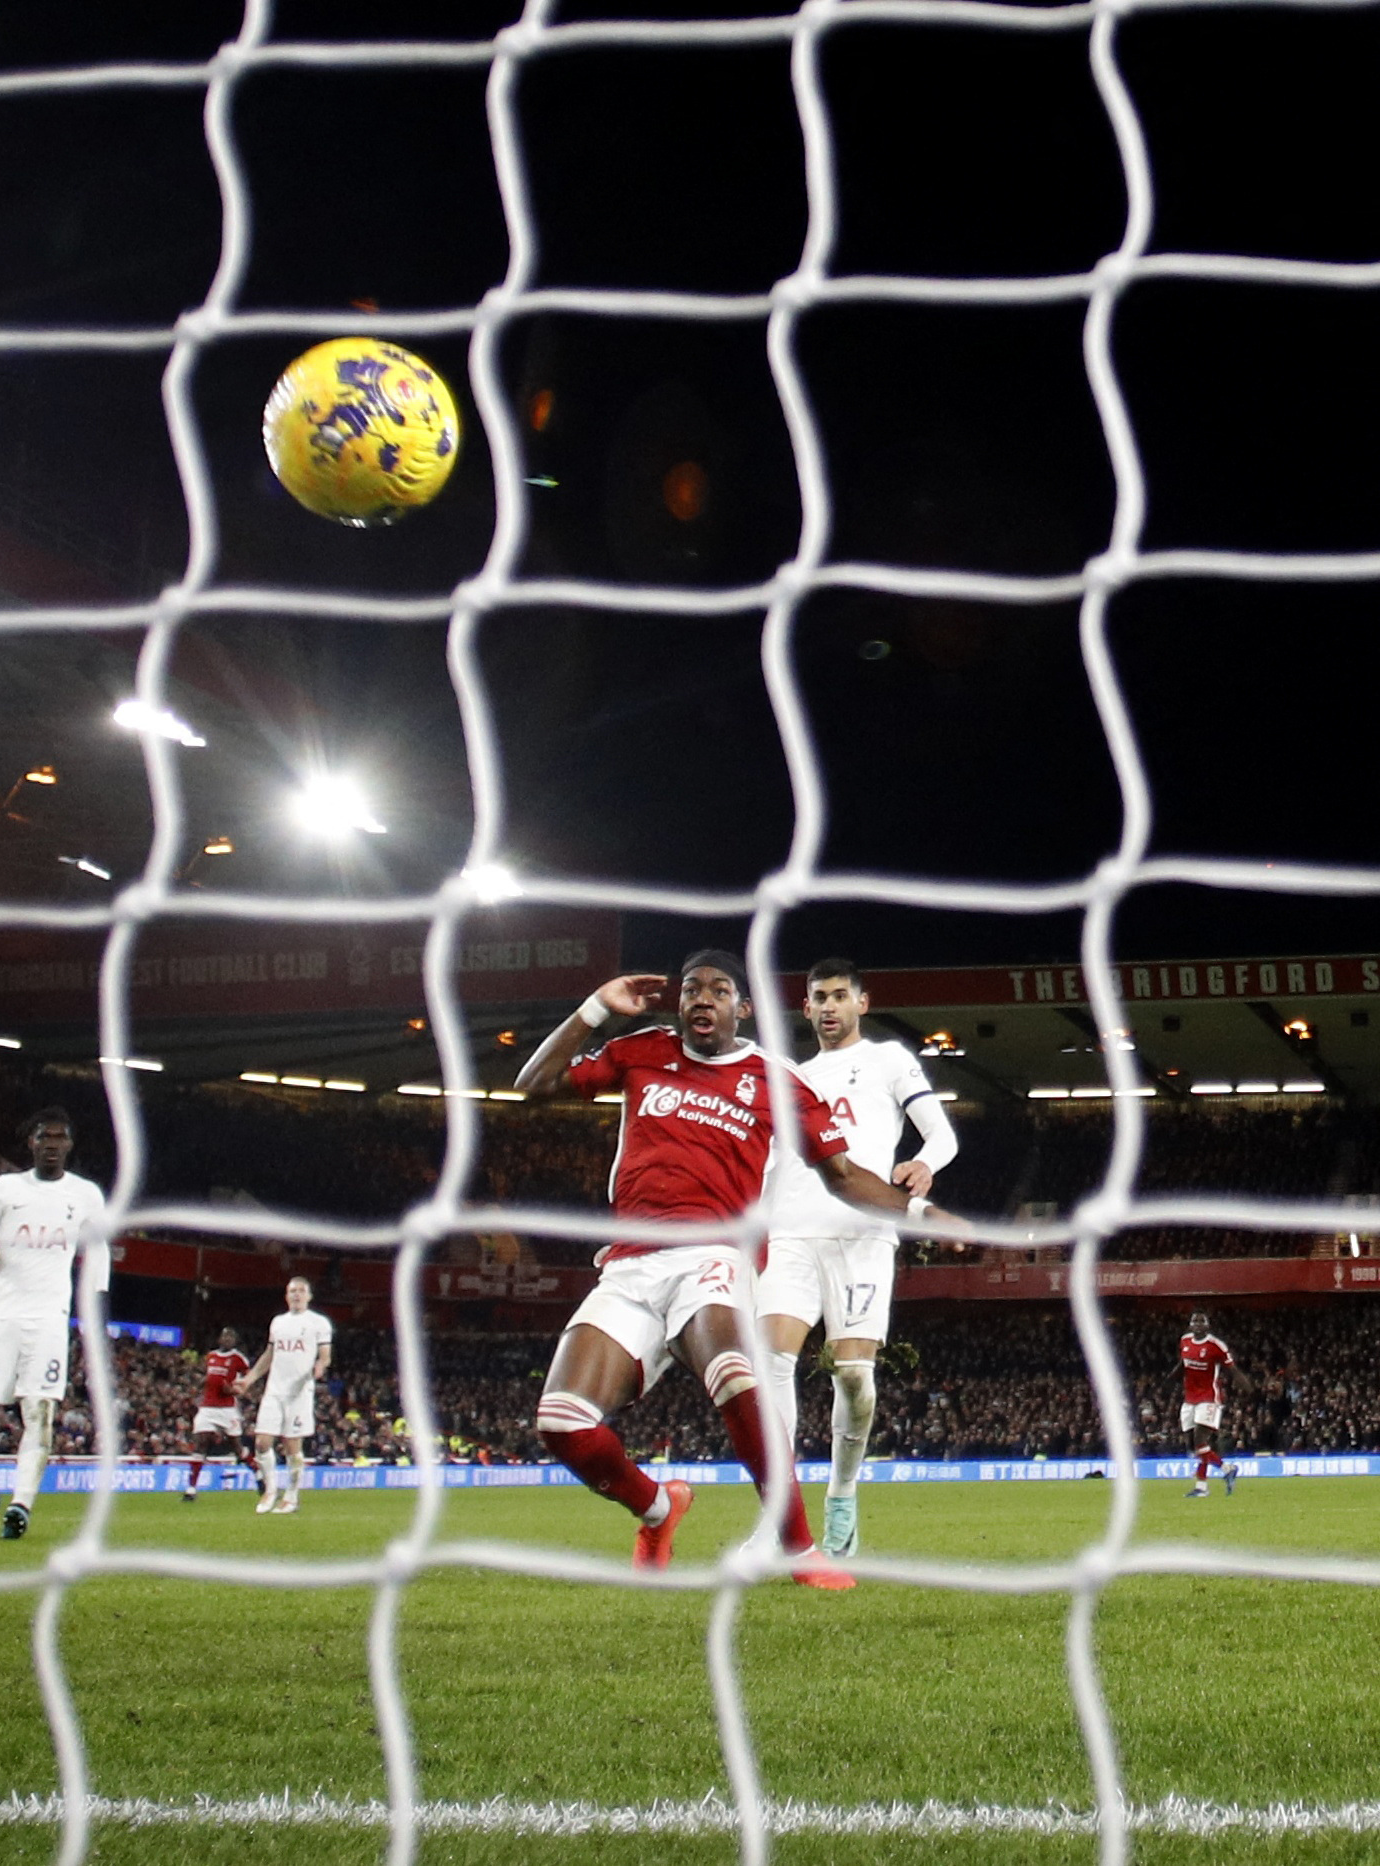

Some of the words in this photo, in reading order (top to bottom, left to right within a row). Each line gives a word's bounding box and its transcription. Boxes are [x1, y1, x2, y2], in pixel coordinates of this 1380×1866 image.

[1009, 968, 1080, 1001] THE
[12, 1224, 68, 1251] AIA
[845, 1283, 876, 1316] 17
[276, 1340, 305, 1352] AIA
[45, 1359, 60, 1383] 8
